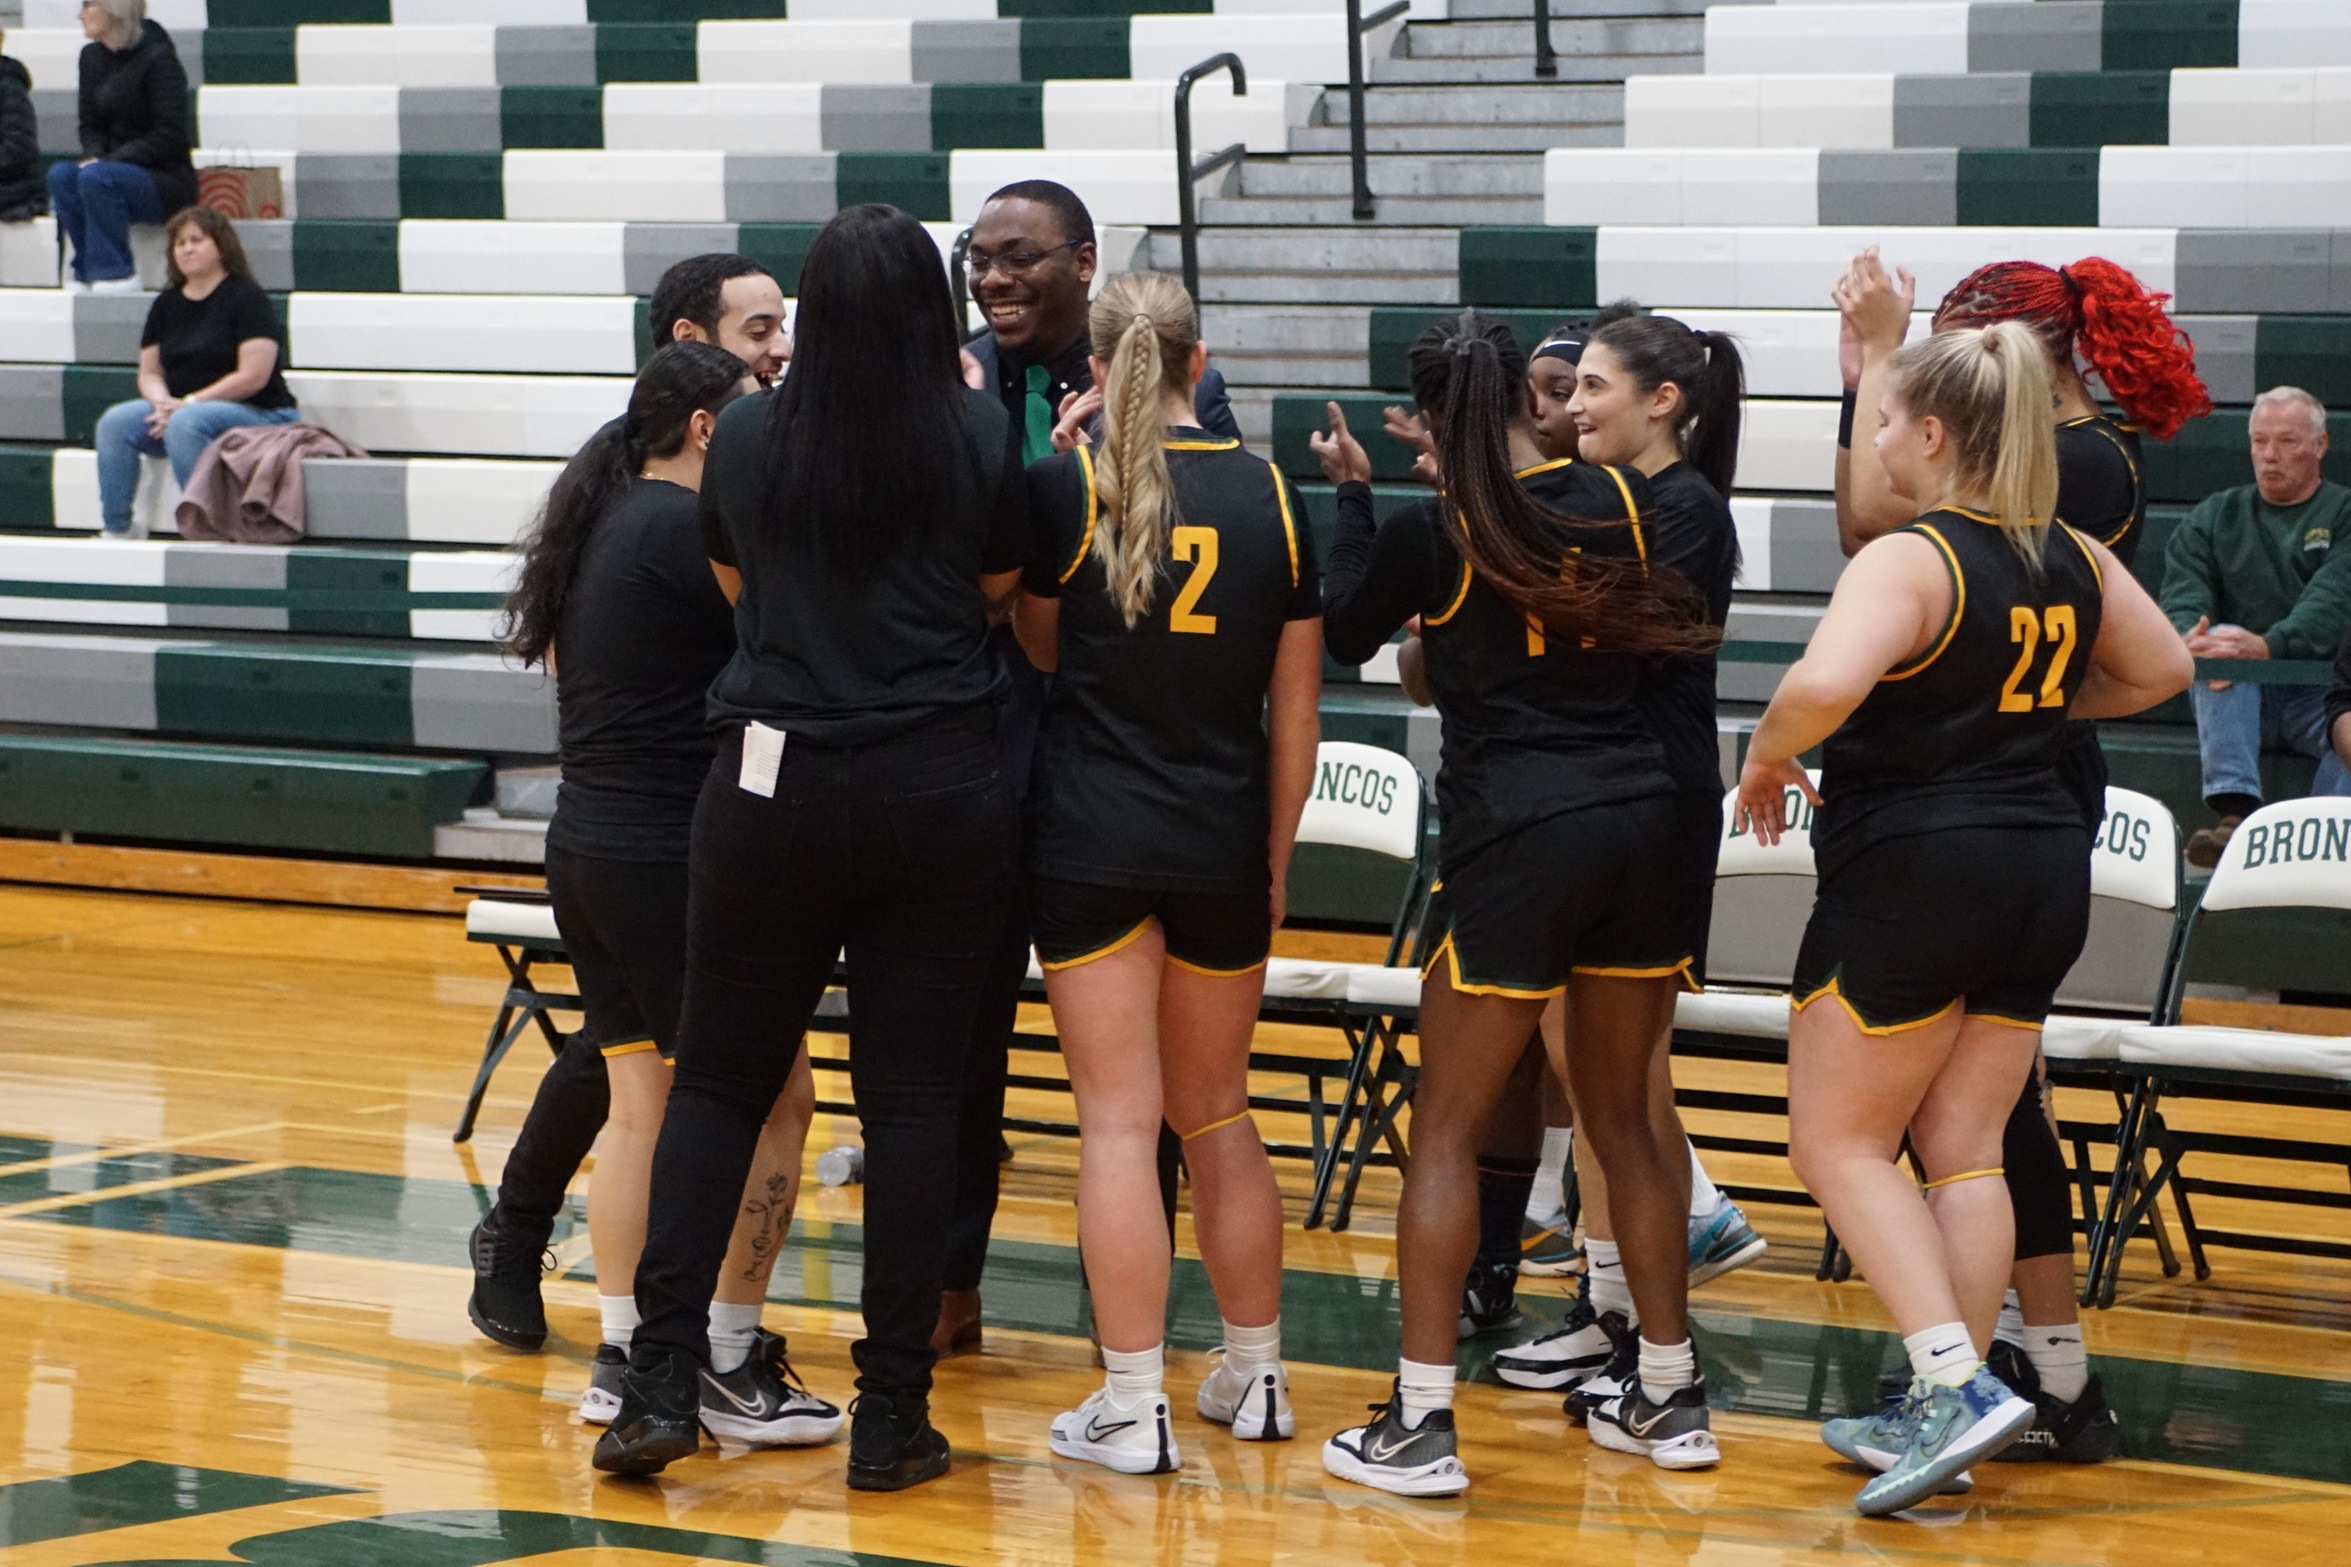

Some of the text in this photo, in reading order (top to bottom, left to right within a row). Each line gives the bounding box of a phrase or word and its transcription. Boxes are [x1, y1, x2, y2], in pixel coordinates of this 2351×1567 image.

[1169, 526, 1218, 634] 2
[1997, 605, 2076, 712] 22
[1309, 761, 1397, 815] NCOS
[2243, 817, 2351, 870] BRON
